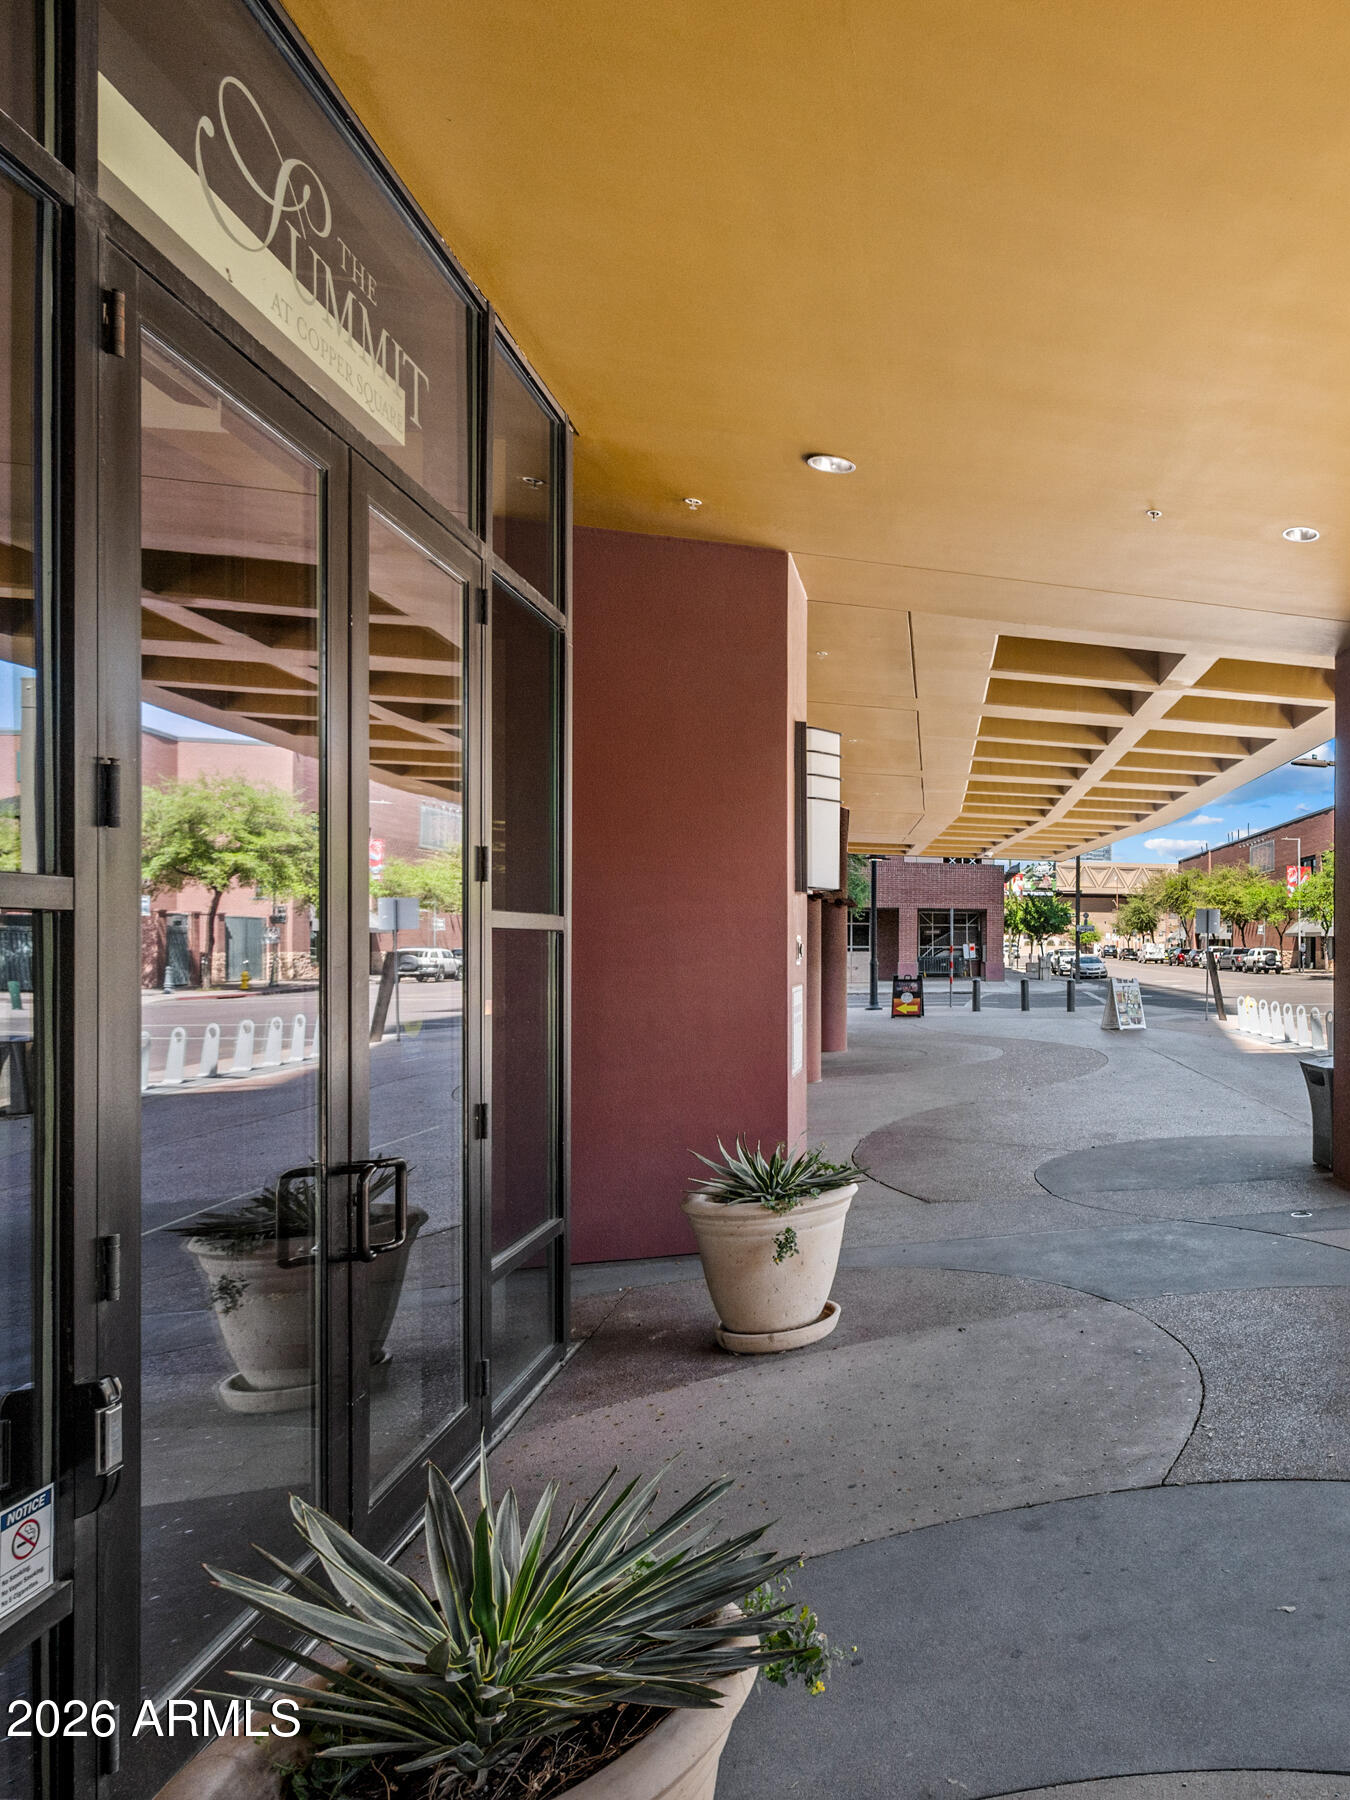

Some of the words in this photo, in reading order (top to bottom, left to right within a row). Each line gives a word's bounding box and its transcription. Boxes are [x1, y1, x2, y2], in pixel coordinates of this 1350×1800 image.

[195, 76, 430, 430] SUMMIT
[337, 236, 378, 306] THE
[271, 292, 294, 325] AT
[297, 315, 355, 386] COPPER
[356, 373, 404, 435] SQUARE
[6, 1493, 46, 1526] NOTICE
